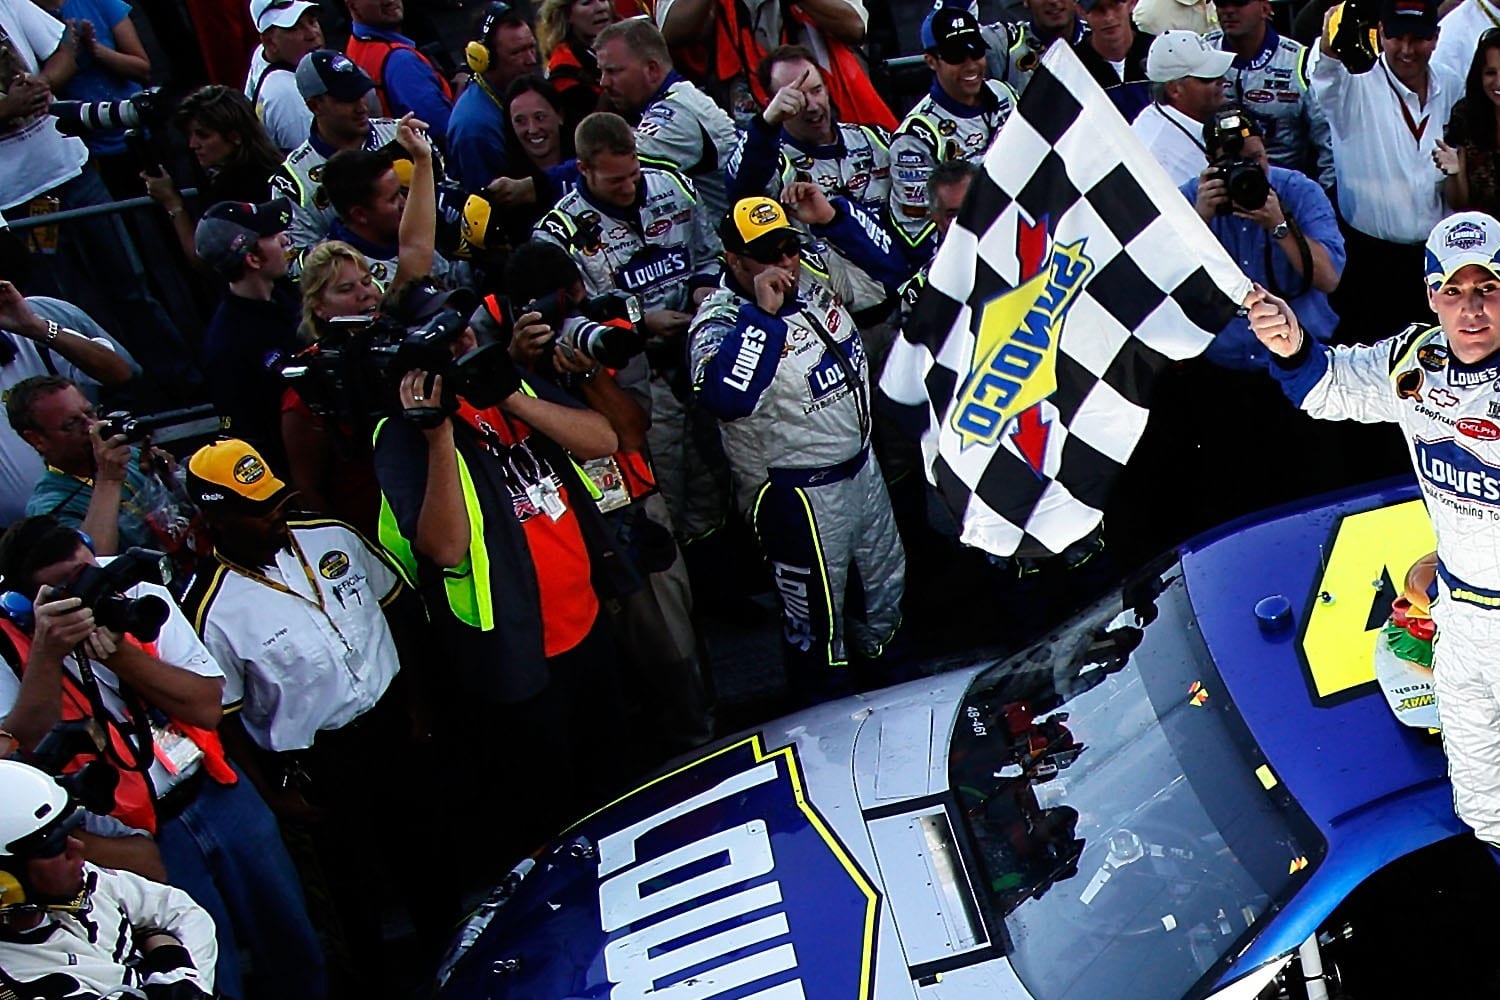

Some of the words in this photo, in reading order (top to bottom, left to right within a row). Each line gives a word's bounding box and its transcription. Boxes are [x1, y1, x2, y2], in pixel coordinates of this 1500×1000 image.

[951, 18, 965, 28] 48
[848, 200, 892, 255] LOWE'S
[624, 252, 686, 289] LOWE'S
[957, 250, 1087, 437] SUNOCO
[722, 325, 768, 393] LOWE'S
[1449, 366, 1499, 386] LOWE'S
[1414, 404, 1456, 426] GOODYEAR
[1459, 421, 1498, 437] DELPHI
[1421, 447, 1500, 501] LOWE'S
[1396, 693, 1435, 711] WAY
